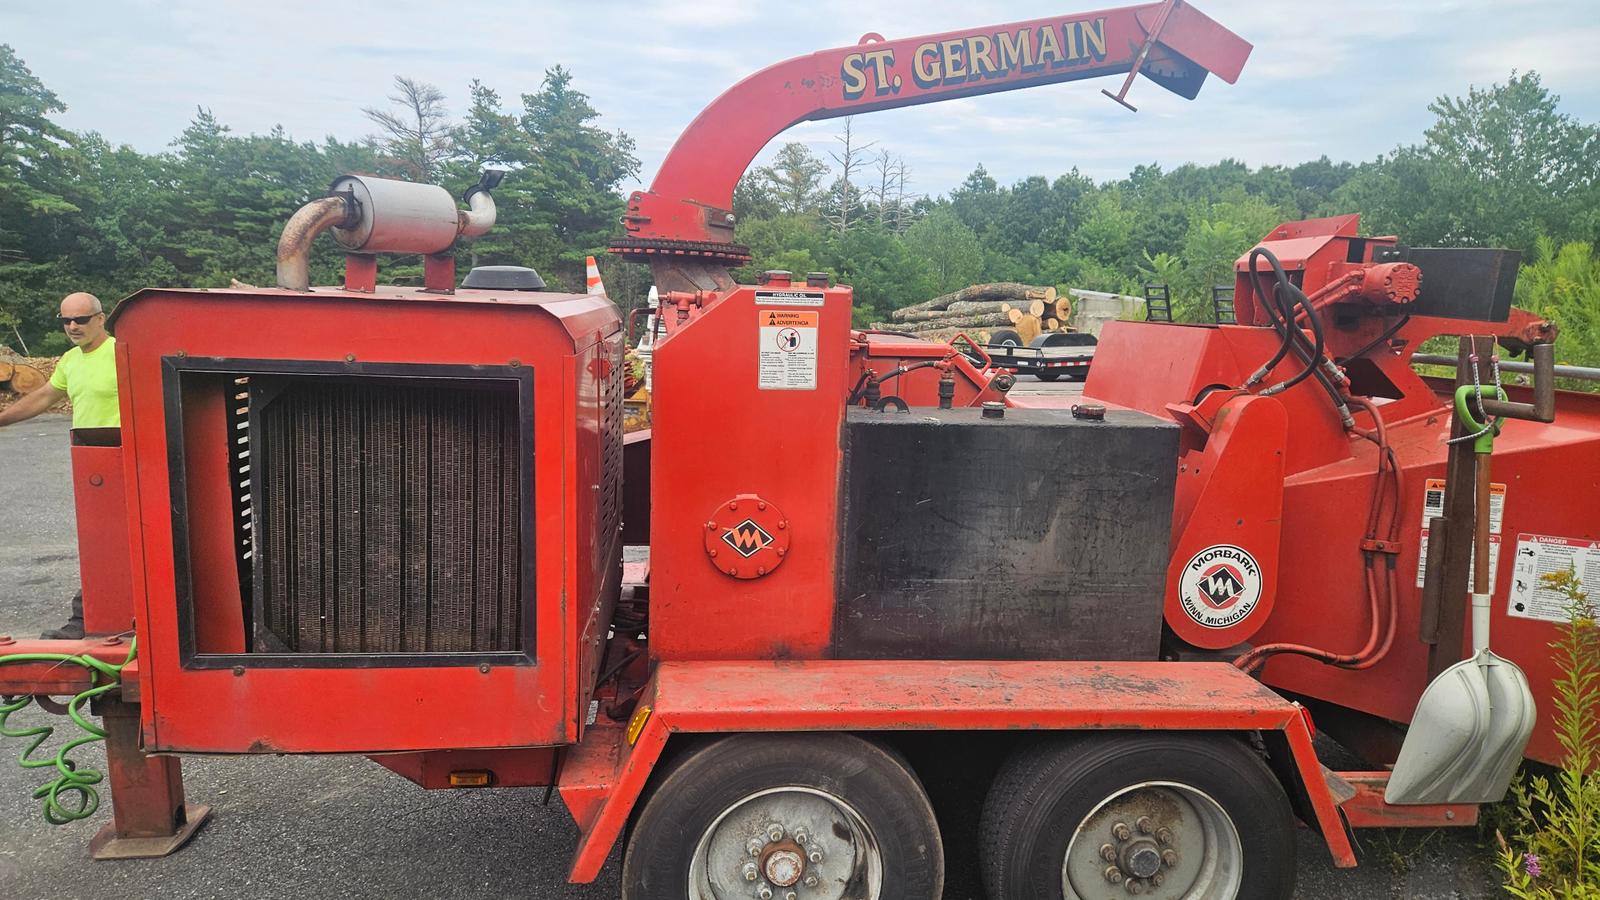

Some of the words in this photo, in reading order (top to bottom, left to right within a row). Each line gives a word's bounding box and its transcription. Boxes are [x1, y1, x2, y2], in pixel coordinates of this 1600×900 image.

[841, 49, 902, 100] ST.
[912, 17, 1108, 89] GERMAIN
[1539, 537, 1568, 545] DANGER
[1191, 549, 1256, 576] MORBARK
[1184, 596, 1205, 622] WINN,
[1204, 602, 1252, 625] MICHIGAN
